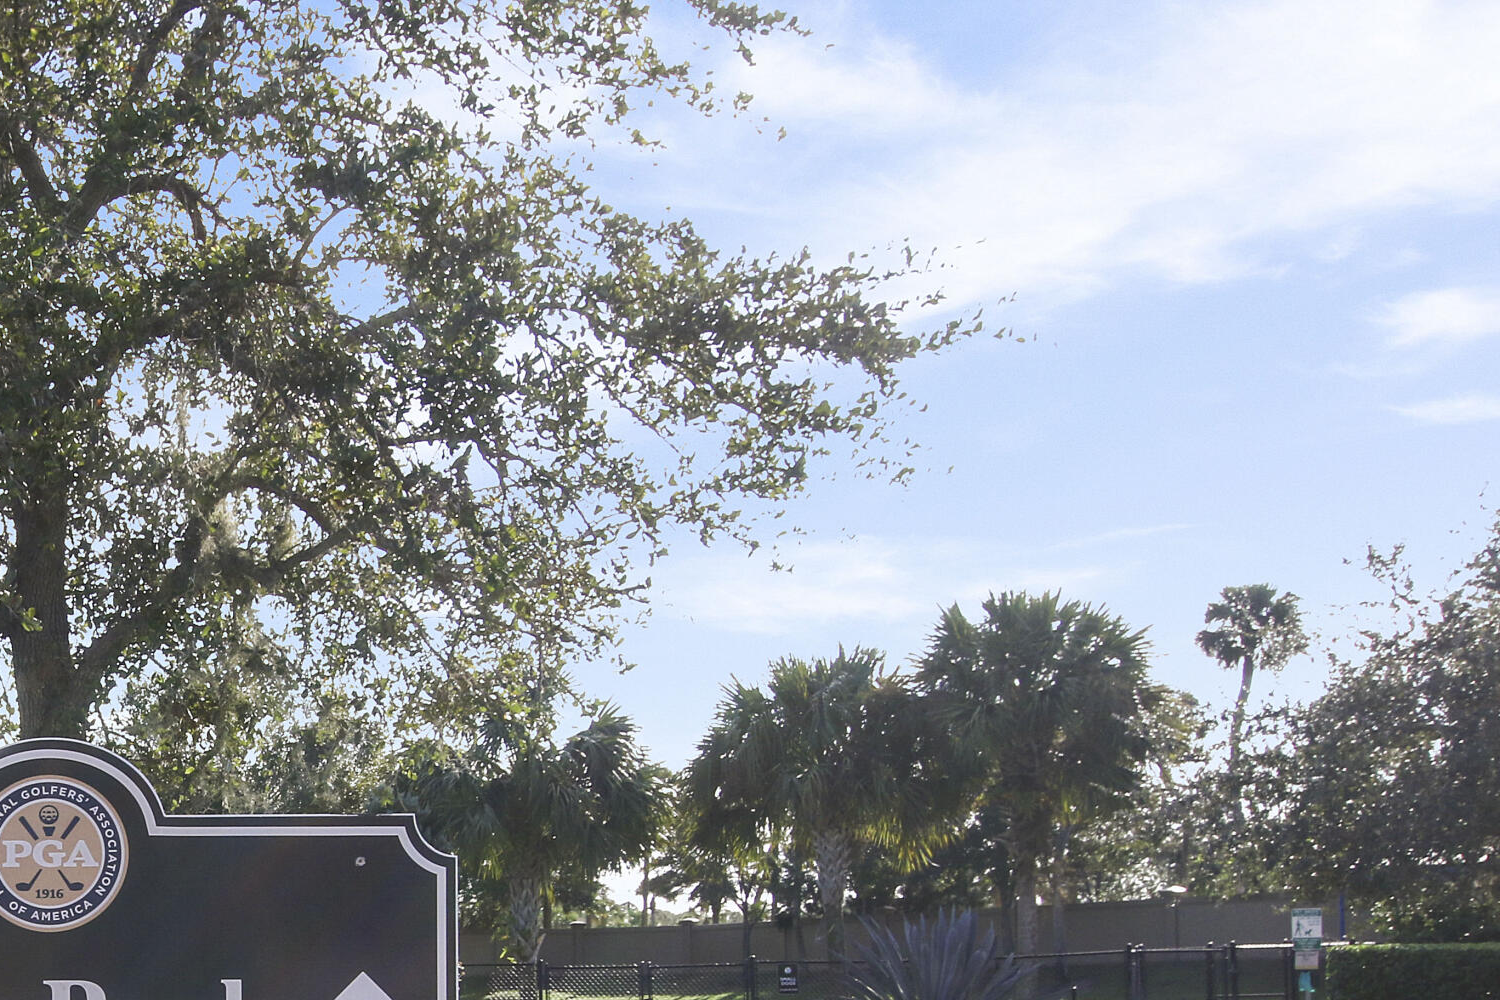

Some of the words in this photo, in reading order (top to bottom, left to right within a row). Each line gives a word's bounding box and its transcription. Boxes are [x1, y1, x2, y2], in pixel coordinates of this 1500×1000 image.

[1, 839, 99, 868] PGA
[89, 806, 117, 897] ASSOCIATION
[35, 888, 64, 899] 1916
[8, 901, 27, 915] OF
[30, 900, 93, 921] AMERICA
